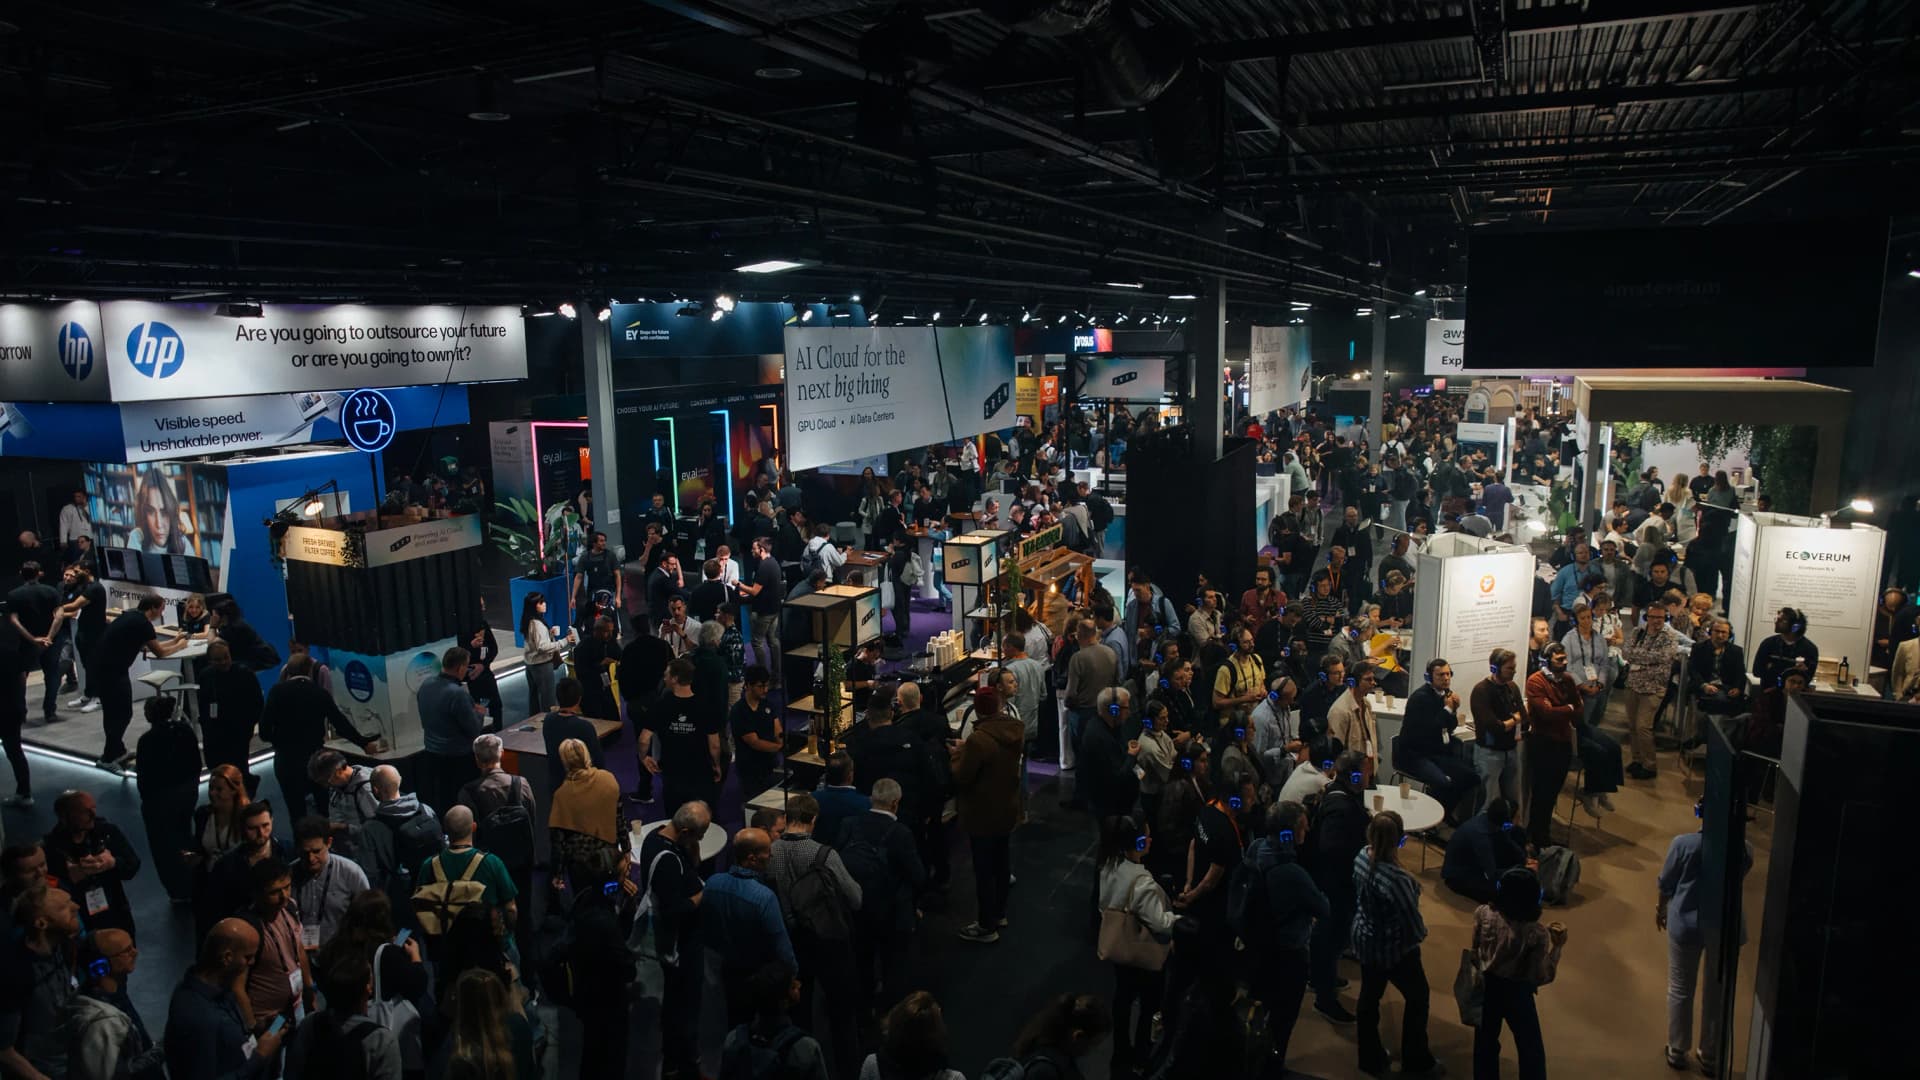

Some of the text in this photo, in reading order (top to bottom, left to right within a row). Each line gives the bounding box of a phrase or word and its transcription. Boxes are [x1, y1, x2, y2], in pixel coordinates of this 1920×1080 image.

[236, 323, 507, 345] Are you going to outsource your future
[626, 329, 639, 341] EY
[1074, 335, 1095, 353] prosus
[64, 320, 91, 382] hp
[134, 321, 179, 379] hp
[292, 345, 472, 369] or are you going to own it?
[796, 343, 905, 371] AI Cloud for the
[798, 371, 890, 403] next big thing
[154, 411, 247, 431] Visible speed.
[798, 416, 837, 432] GPU Cloud
[850, 411, 895, 425] AI Data Centers
[140, 431, 264, 453] Unshakable power.
[1785, 550, 1852, 562] ECOVERUM
